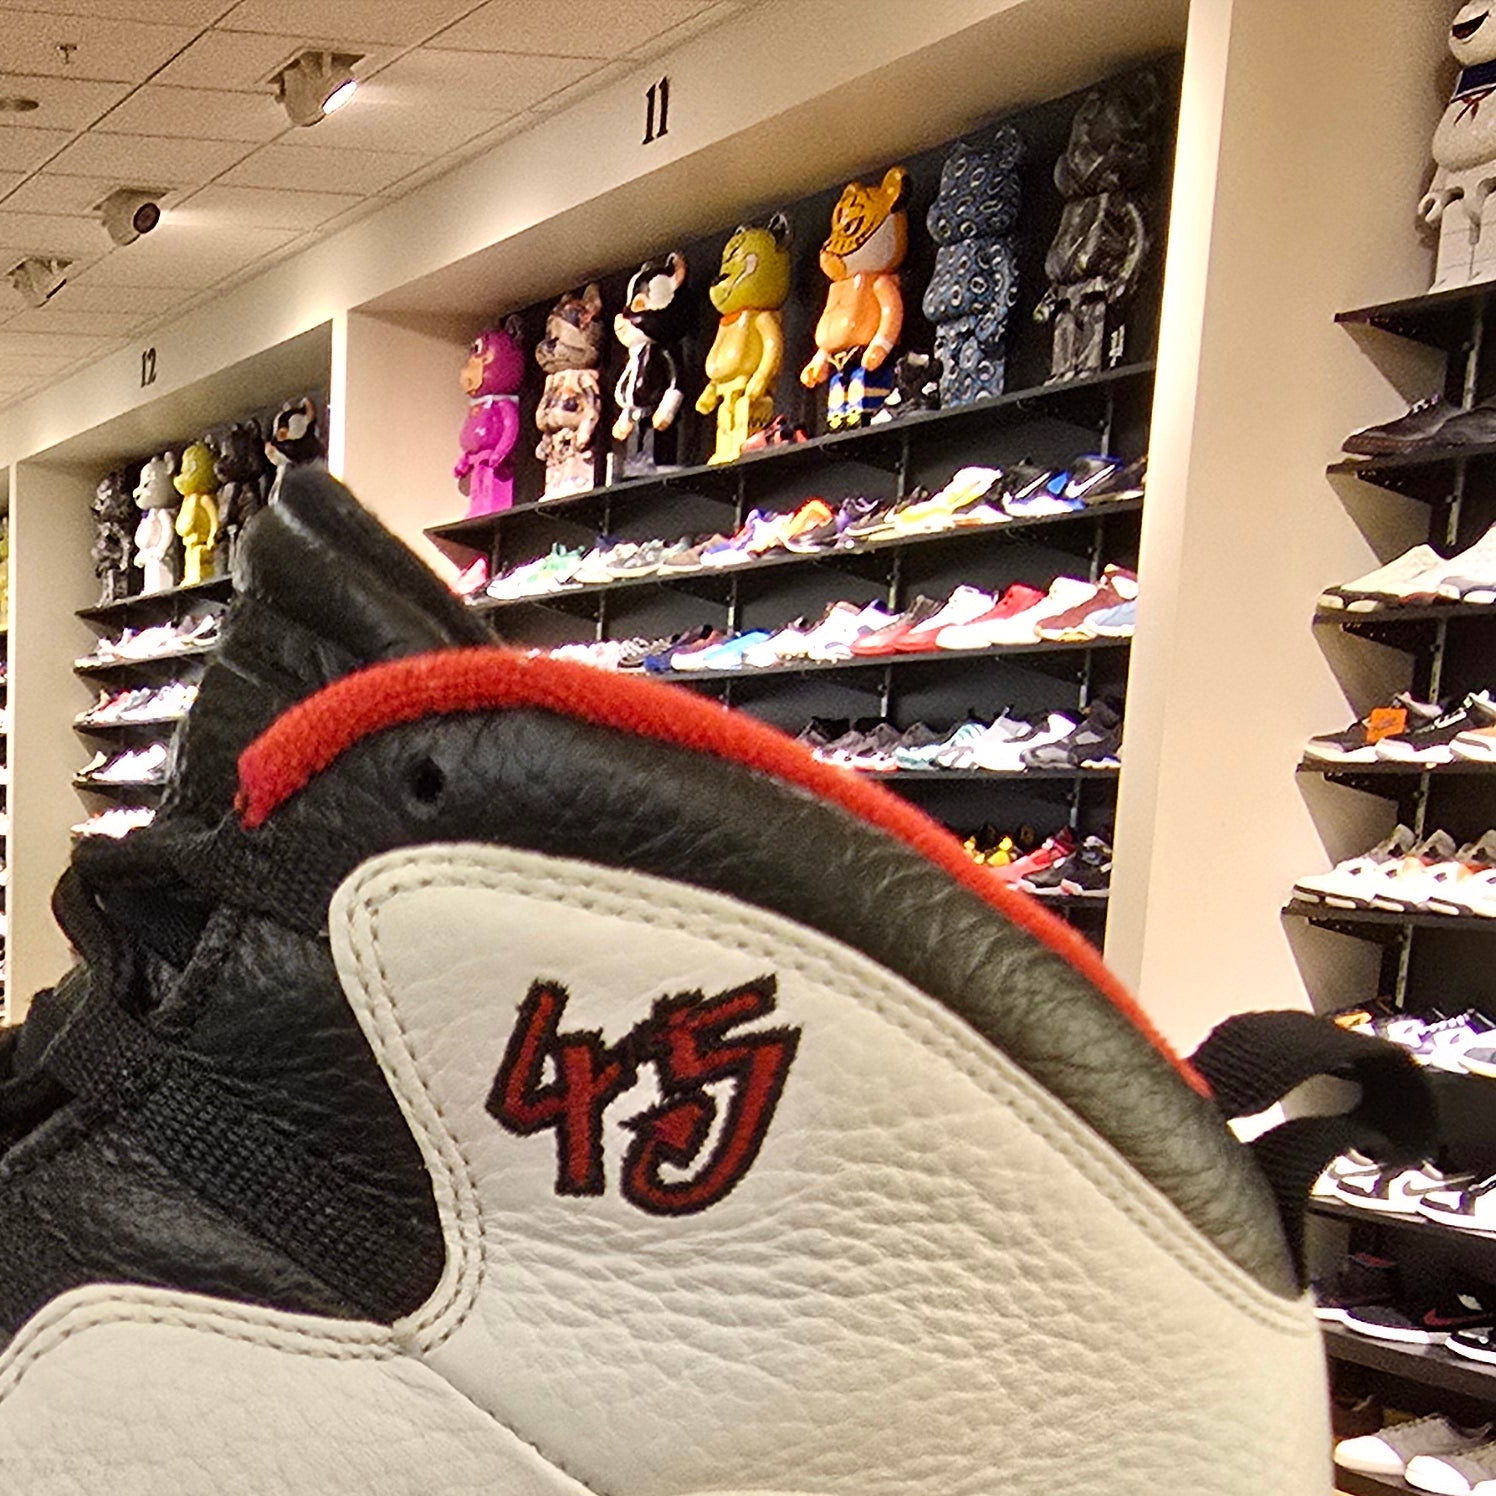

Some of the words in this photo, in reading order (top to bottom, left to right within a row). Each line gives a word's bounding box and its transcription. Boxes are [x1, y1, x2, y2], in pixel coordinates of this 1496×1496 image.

[642, 75, 671, 145] 11
[140, 347, 157, 388] 12
[485, 972, 803, 1217] 45
